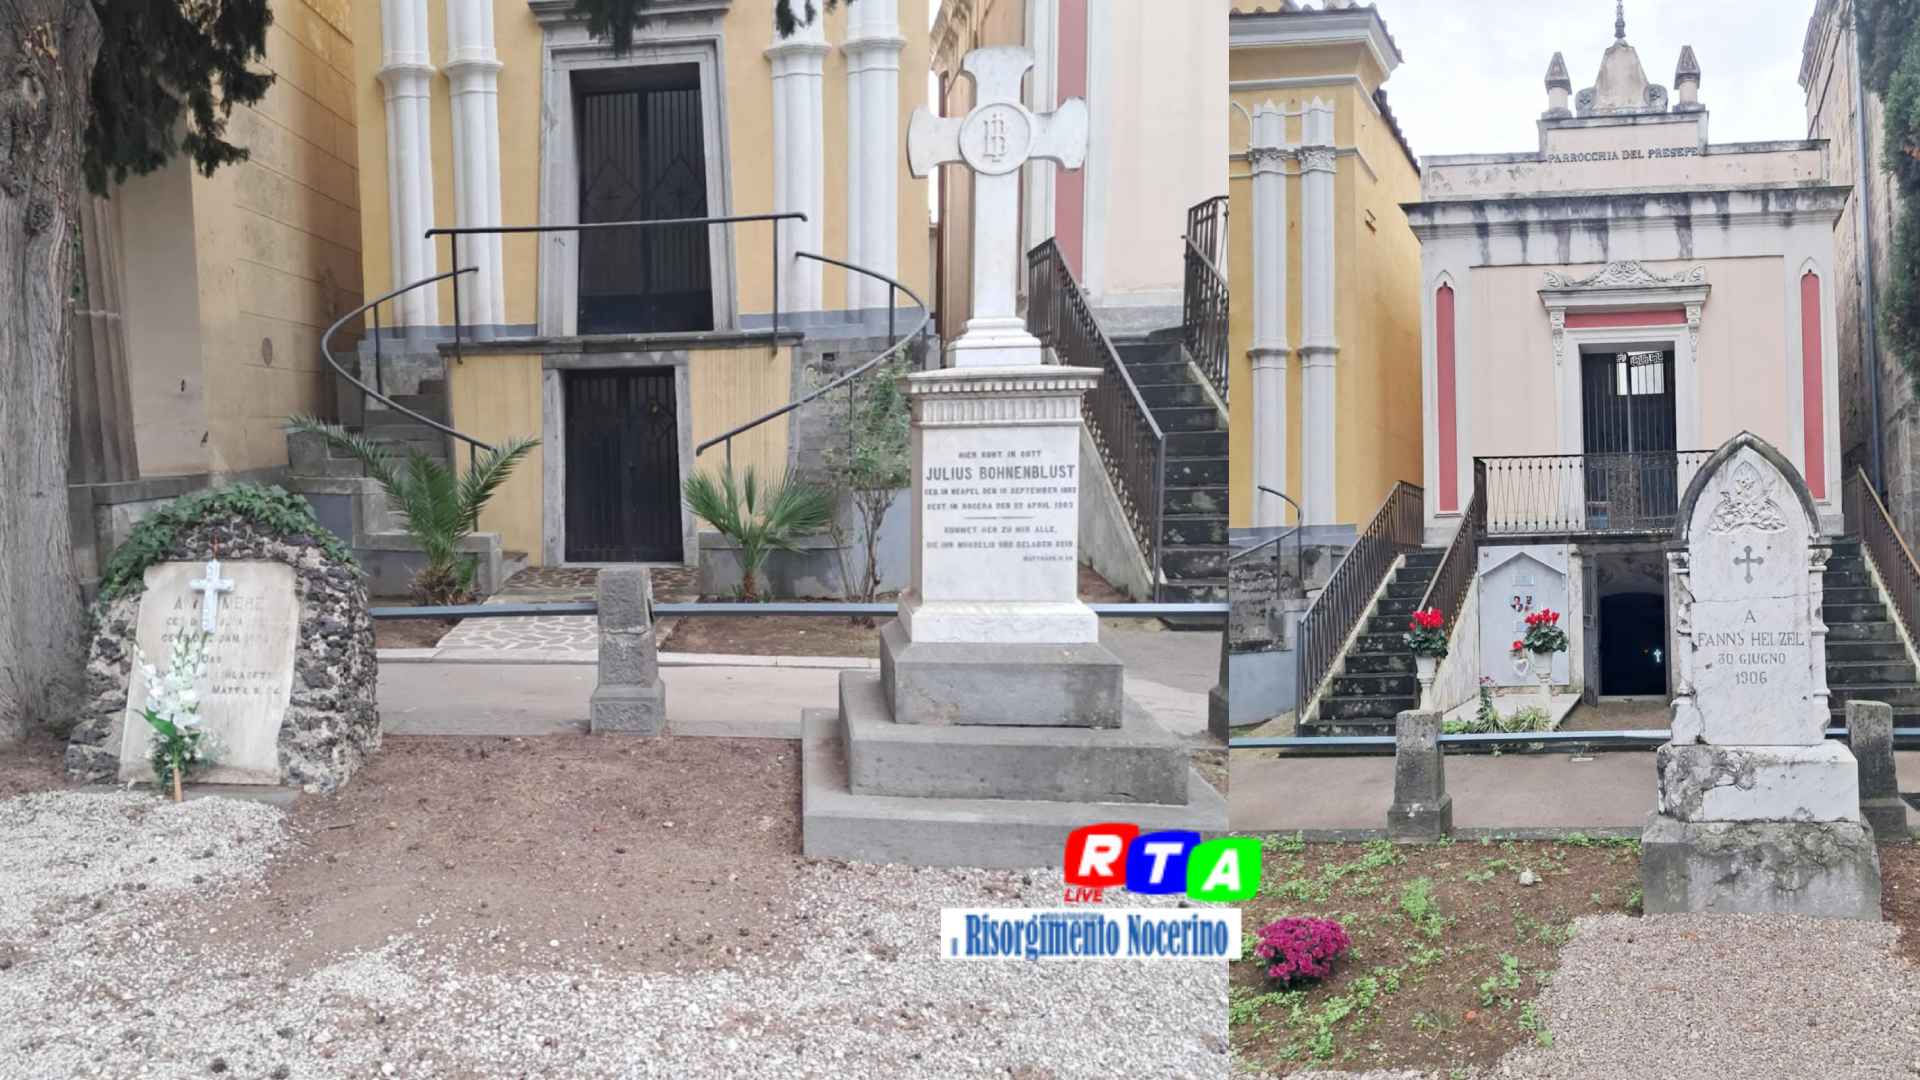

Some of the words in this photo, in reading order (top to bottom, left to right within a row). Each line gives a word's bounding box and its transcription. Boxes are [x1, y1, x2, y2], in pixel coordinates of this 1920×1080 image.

[1548, 152, 1619, 164] PARROCCHIA
[1622, 150, 1645, 160] DEL
[1648, 147, 1699, 159] PRESEPE
[926, 466, 973, 480] JULIUS
[979, 464, 1076, 480] BOHNENBLUST
[1744, 609, 1757, 623] A
[1718, 653, 1734, 665] 30
[1739, 652, 1787, 665] GIUGNO
[1735, 671, 1768, 685] 1906
